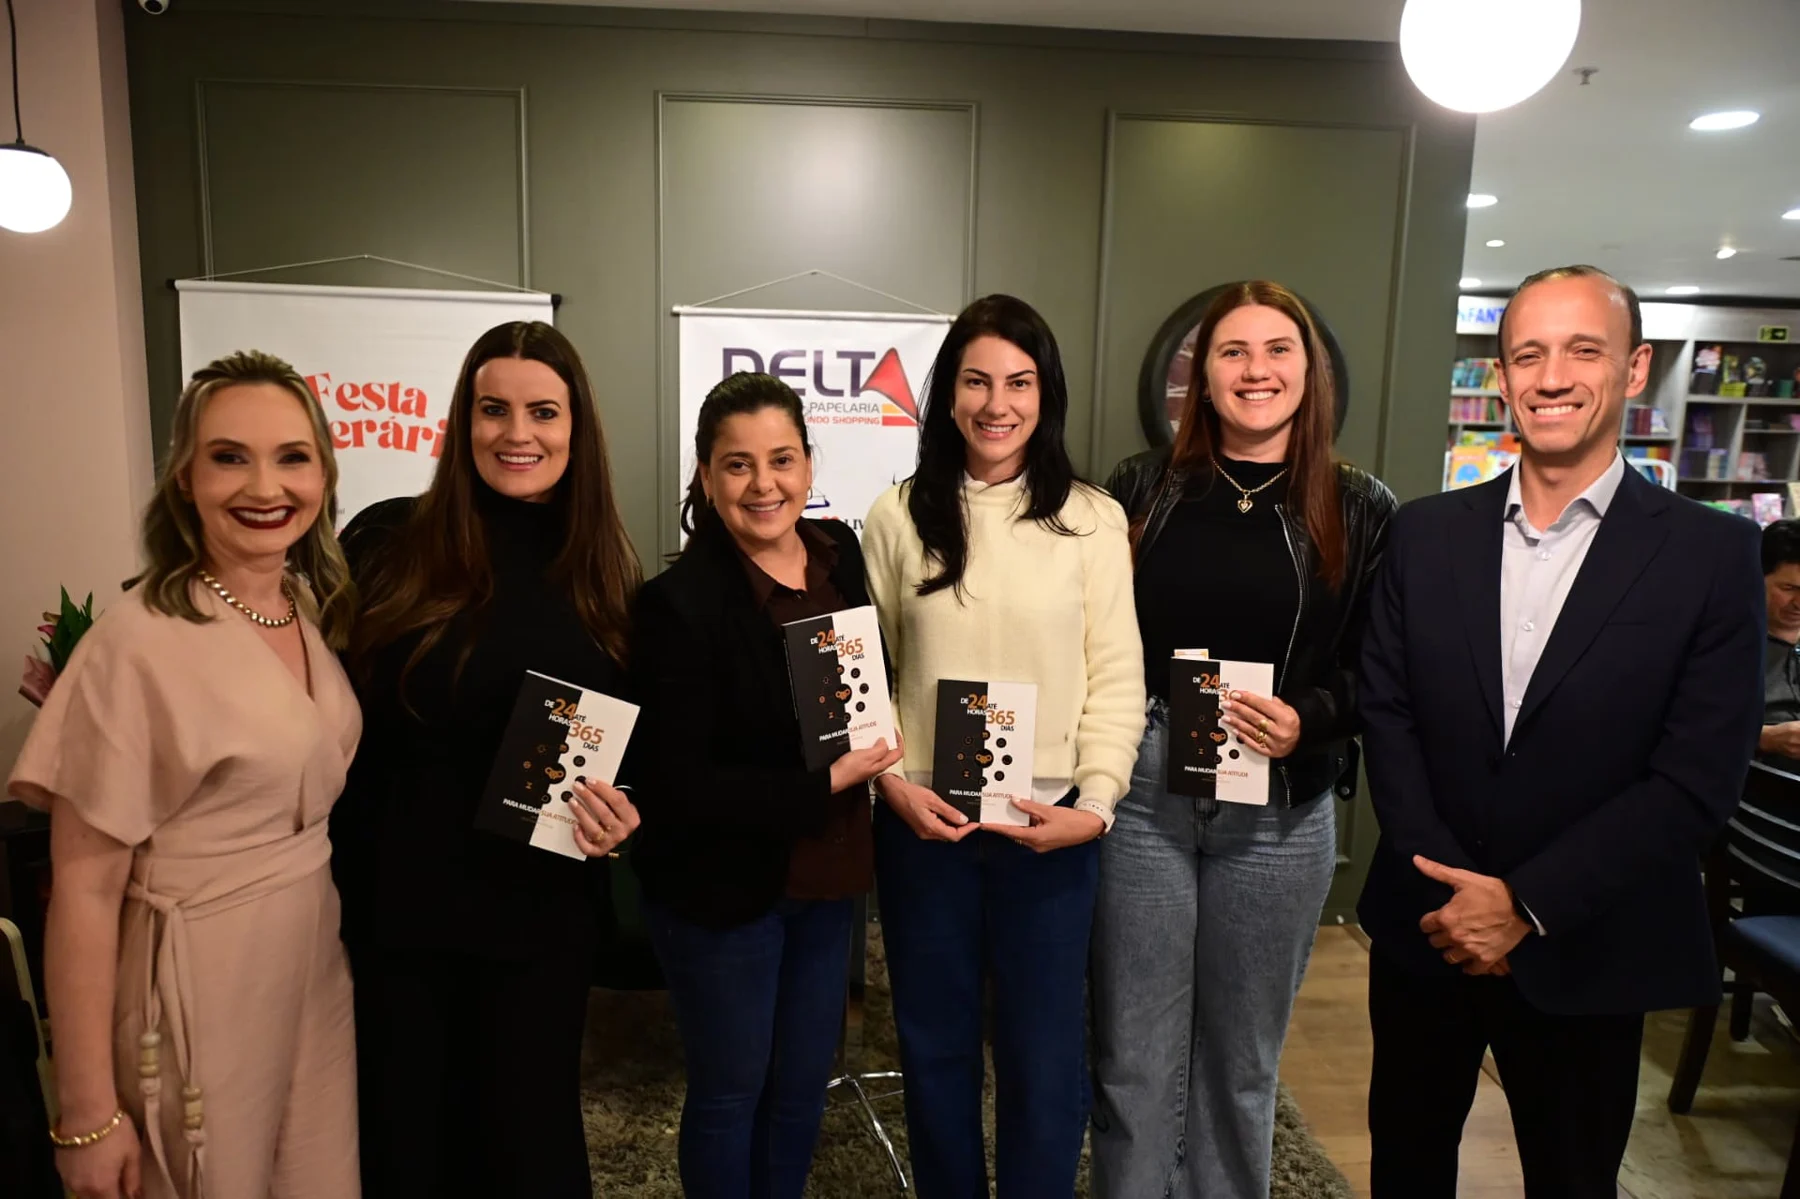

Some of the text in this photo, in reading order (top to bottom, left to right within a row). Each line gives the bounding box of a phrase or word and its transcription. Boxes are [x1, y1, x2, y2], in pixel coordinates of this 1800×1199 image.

[304, 372, 427, 418] Festa
[809, 402, 880, 413] PAPELARIA
[832, 417, 880, 425] SHOPPING
[329, 415, 447, 460] erári
[810, 629, 836, 646] DE 24
[818, 645, 839, 654] HORAS
[837, 638, 864, 657] 365
[852, 653, 865, 661] DIAS
[1200, 673, 1220, 689] 24
[545, 698, 577, 720] DE 24
[968, 694, 987, 710] 24
[548, 713, 573, 727] HORAS
[986, 710, 1015, 725] 365
[568, 720, 604, 744] 365
[818, 733, 832, 742] PARA
[583, 742, 599, 751] DIAS
[1227, 770, 1248, 778] ATITUDE
[503, 798, 518, 808] PARA
